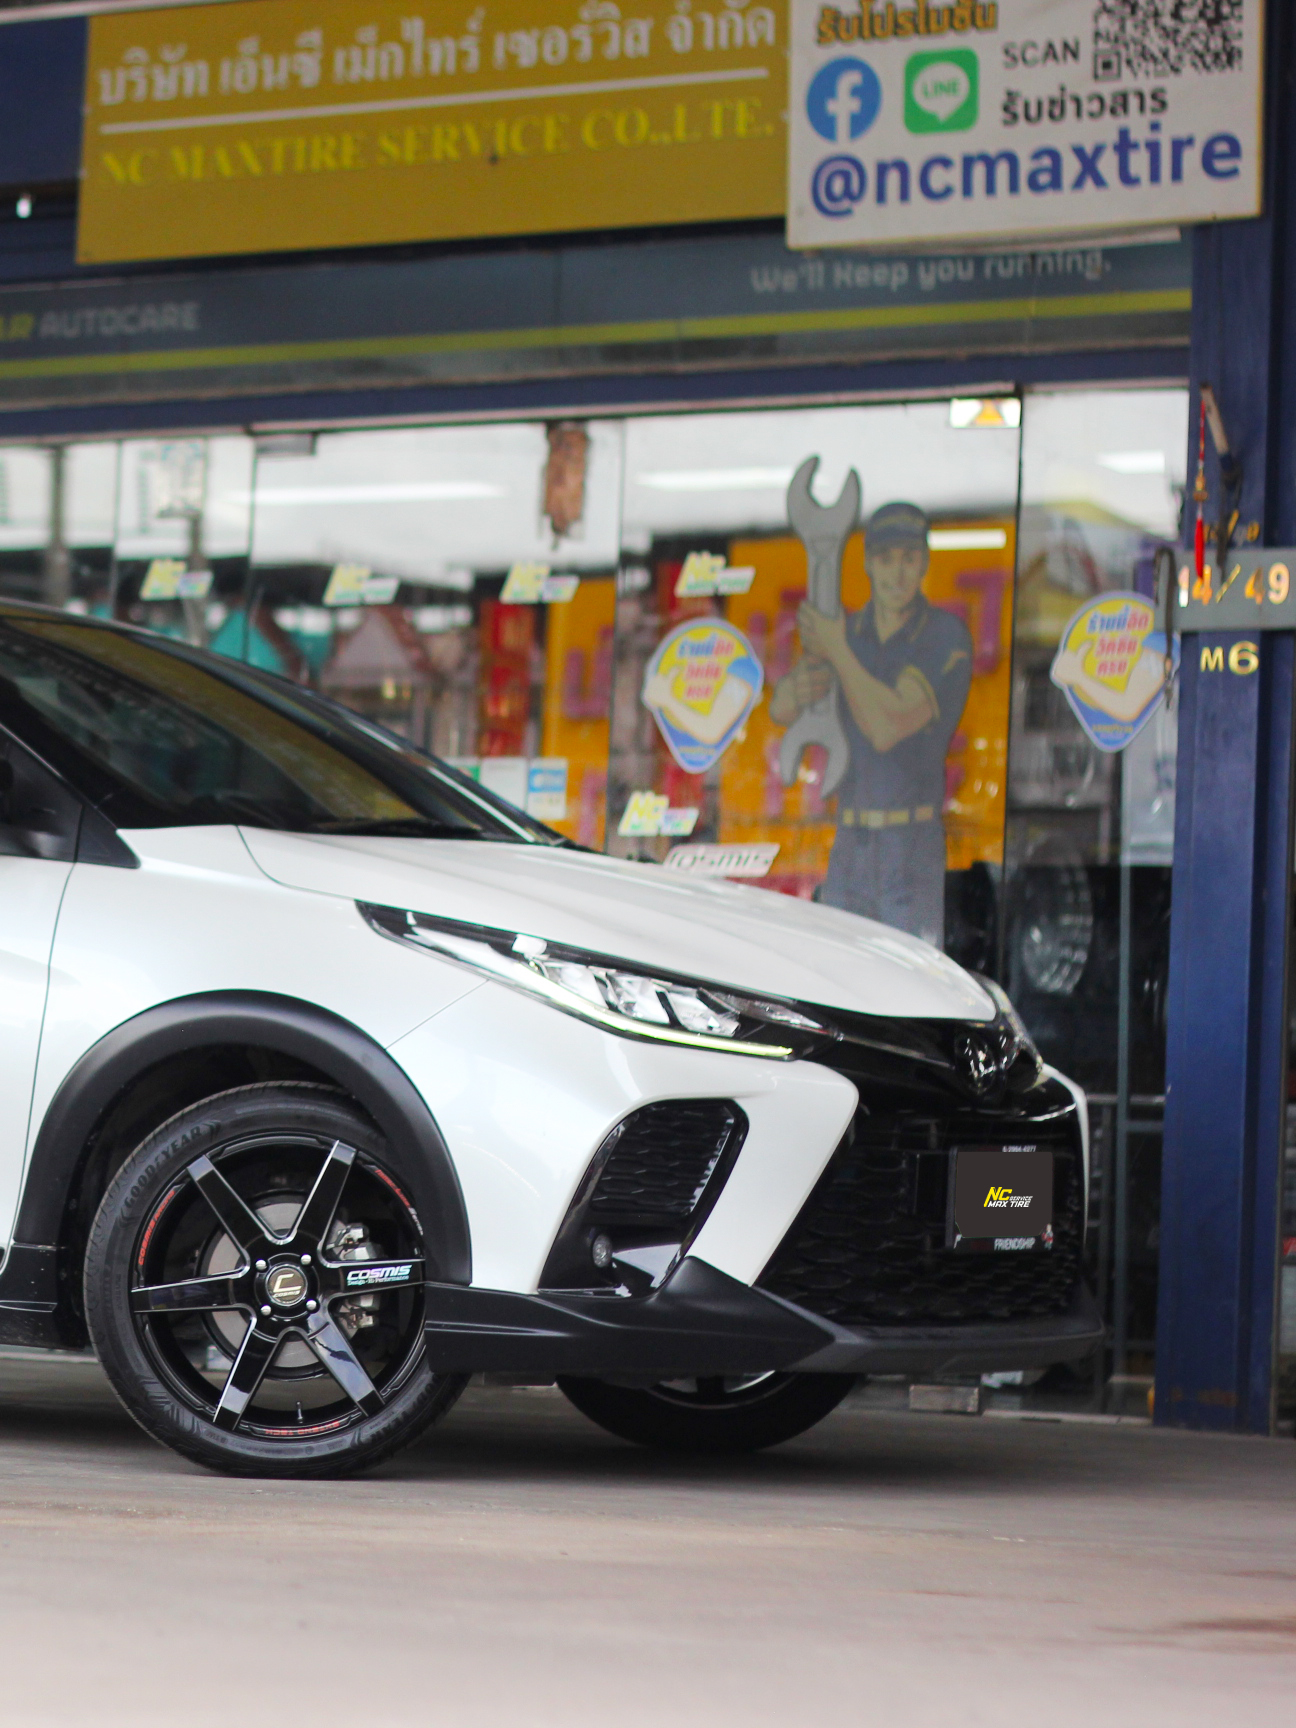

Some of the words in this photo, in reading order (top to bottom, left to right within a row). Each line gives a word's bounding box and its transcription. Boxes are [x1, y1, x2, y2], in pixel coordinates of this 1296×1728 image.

[1003, 37, 1080, 68] SCAN
[99, 43, 209, 106] บริษัท
[922, 78, 960, 98] LINE
[1002, 83, 1168, 127] รับข่าวสาร
[102, 150, 147, 185] NC
[170, 131, 365, 181] MAXTIRE
[377, 112, 573, 167] SERVICE
[811, 121, 1242, 218] @ncmaxtire
[916, 256, 976, 292] you
[39, 302, 201, 340] AUTOCARE
[124, 1125, 202, 1209] GOODYEAR
[994, 1237, 1036, 1250] FRIENDSHIP
[347, 1264, 413, 1281] COSMIS
[272, 1290, 301, 1298] COSMIS
